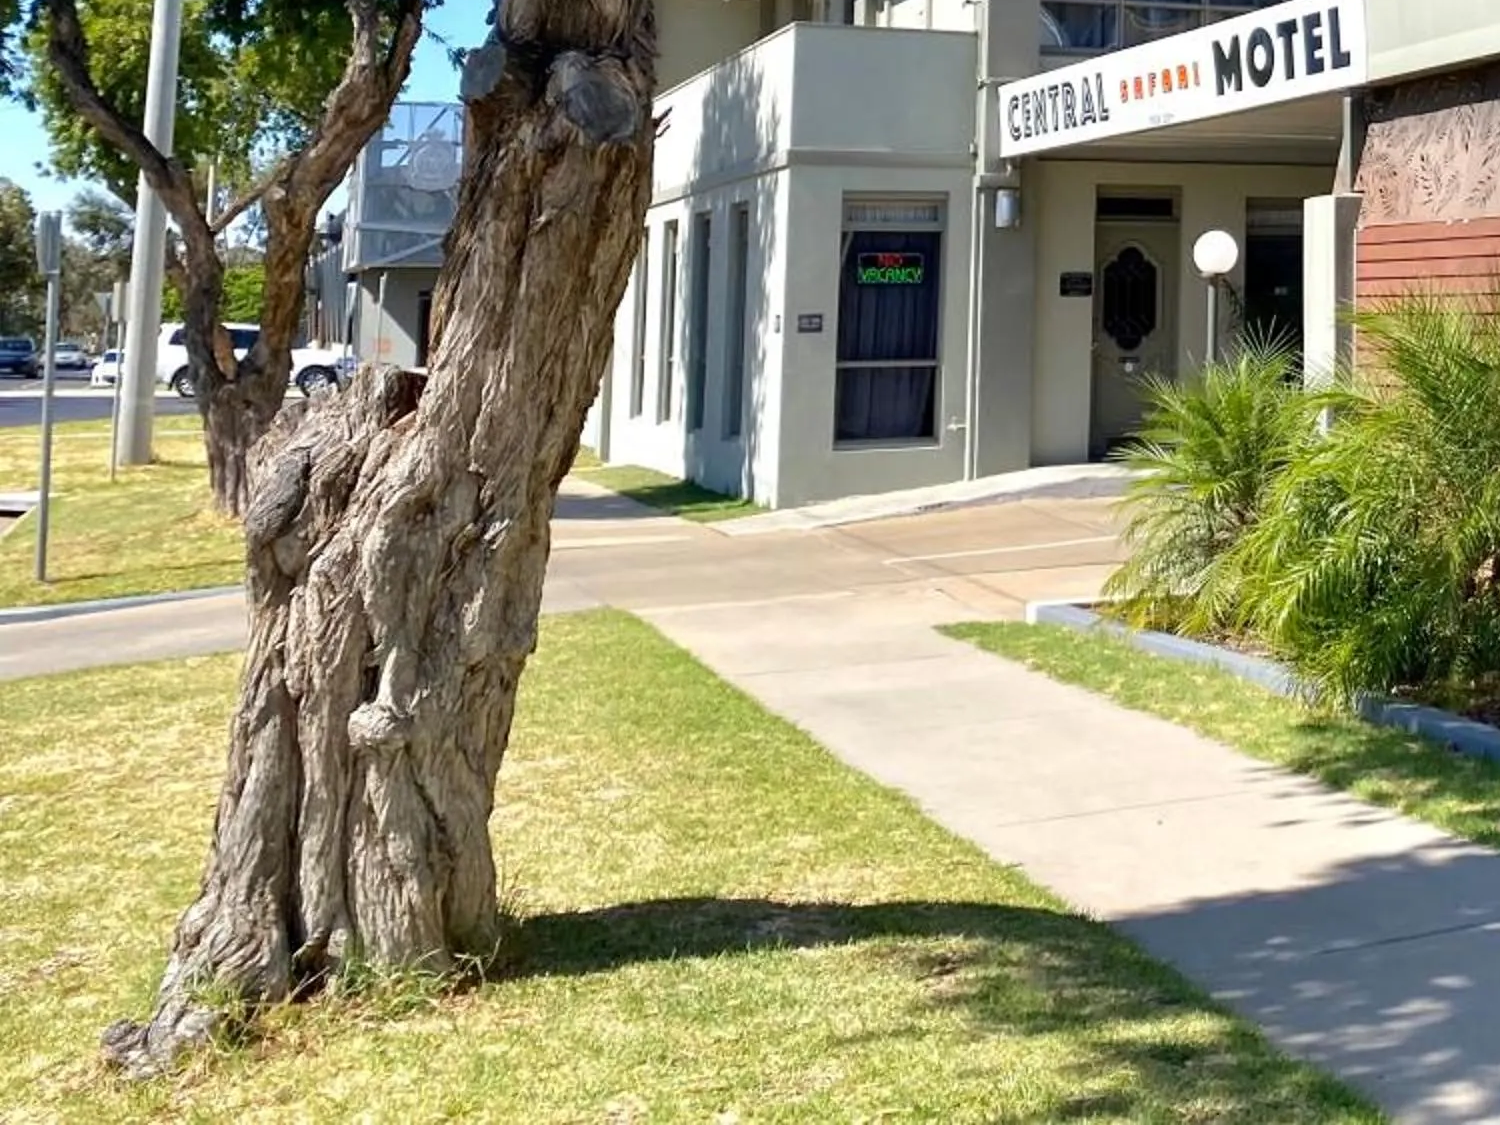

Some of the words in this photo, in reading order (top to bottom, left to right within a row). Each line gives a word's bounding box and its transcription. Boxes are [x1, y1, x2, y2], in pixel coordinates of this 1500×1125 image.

[1007, 72, 1110, 142] CENTRAL
[1119, 61, 1201, 105] SAFARI
[1211, 6, 1352, 96] MOTEL
[860, 266, 922, 284] VACANCY
